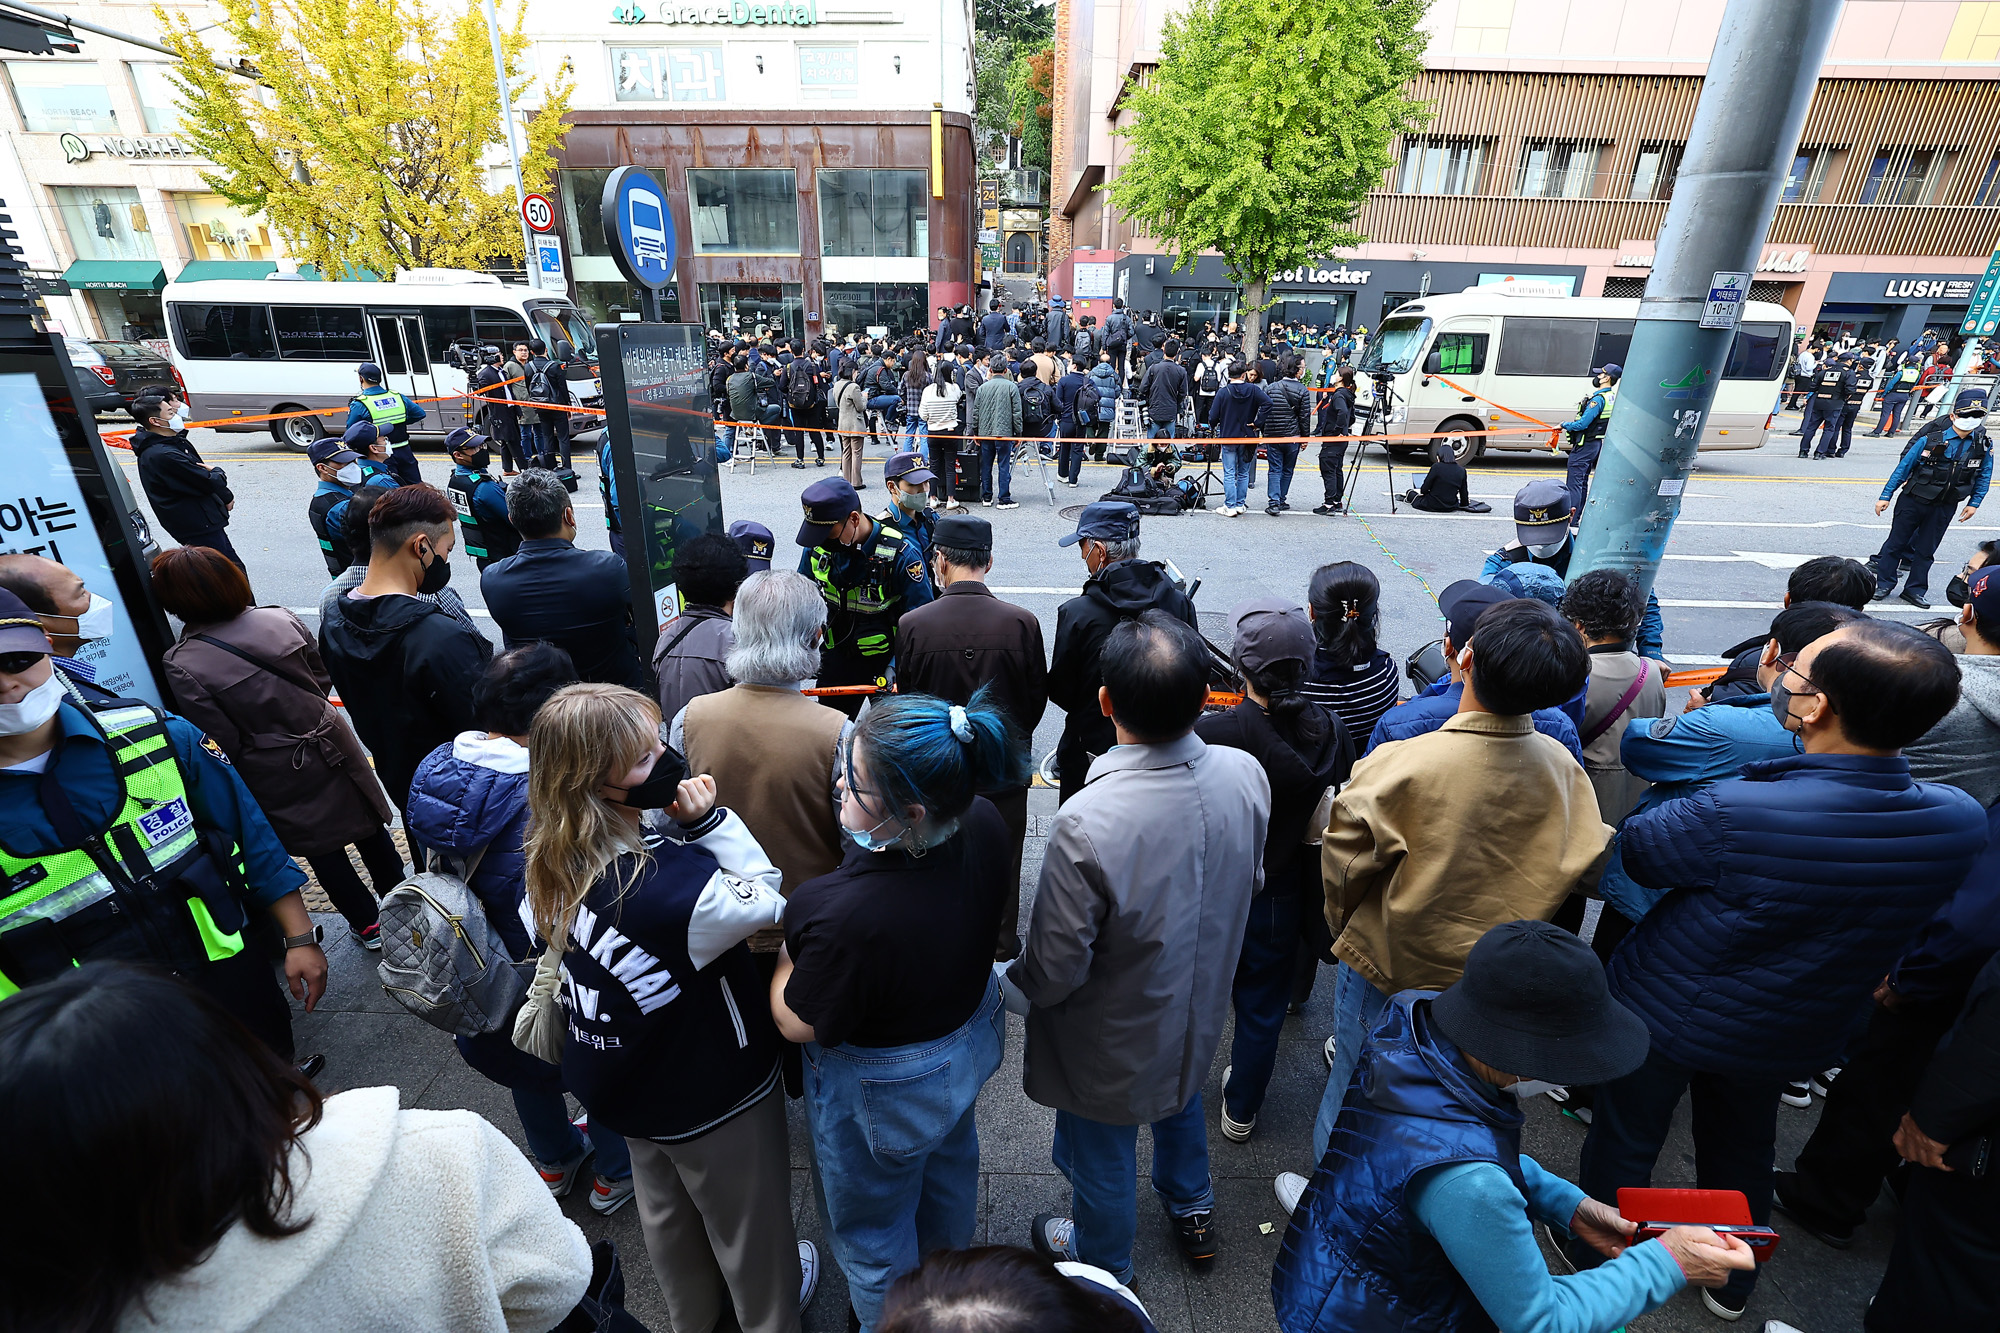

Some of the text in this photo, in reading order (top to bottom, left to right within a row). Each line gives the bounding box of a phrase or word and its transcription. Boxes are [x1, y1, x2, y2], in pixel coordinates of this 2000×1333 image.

[659, 0, 818, 26] GraceDental
[622, 51, 722, 99] 치과
[70, 108, 97, 116] BEACH
[100, 137, 187, 159] NORTH
[983, 191, 996, 200] 24
[530, 203, 547, 223] 50
[1264, 266, 1371, 284] oot Locker
[1716, 291, 1738, 300] 이태원로
[1885, 280, 1974, 297] LUSH FRESH
[1712, 303, 1735, 316] 10-13
[646, 388, 664, 401] 정류소
[0, 496, 77, 541] 아는
[89, 637, 110, 650] 하지만
[102, 671, 130, 687] 책임에서
[113, 680, 135, 692] 때문에
[143, 801, 185, 830] 경찰
[153, 815, 190, 841] POLICE
